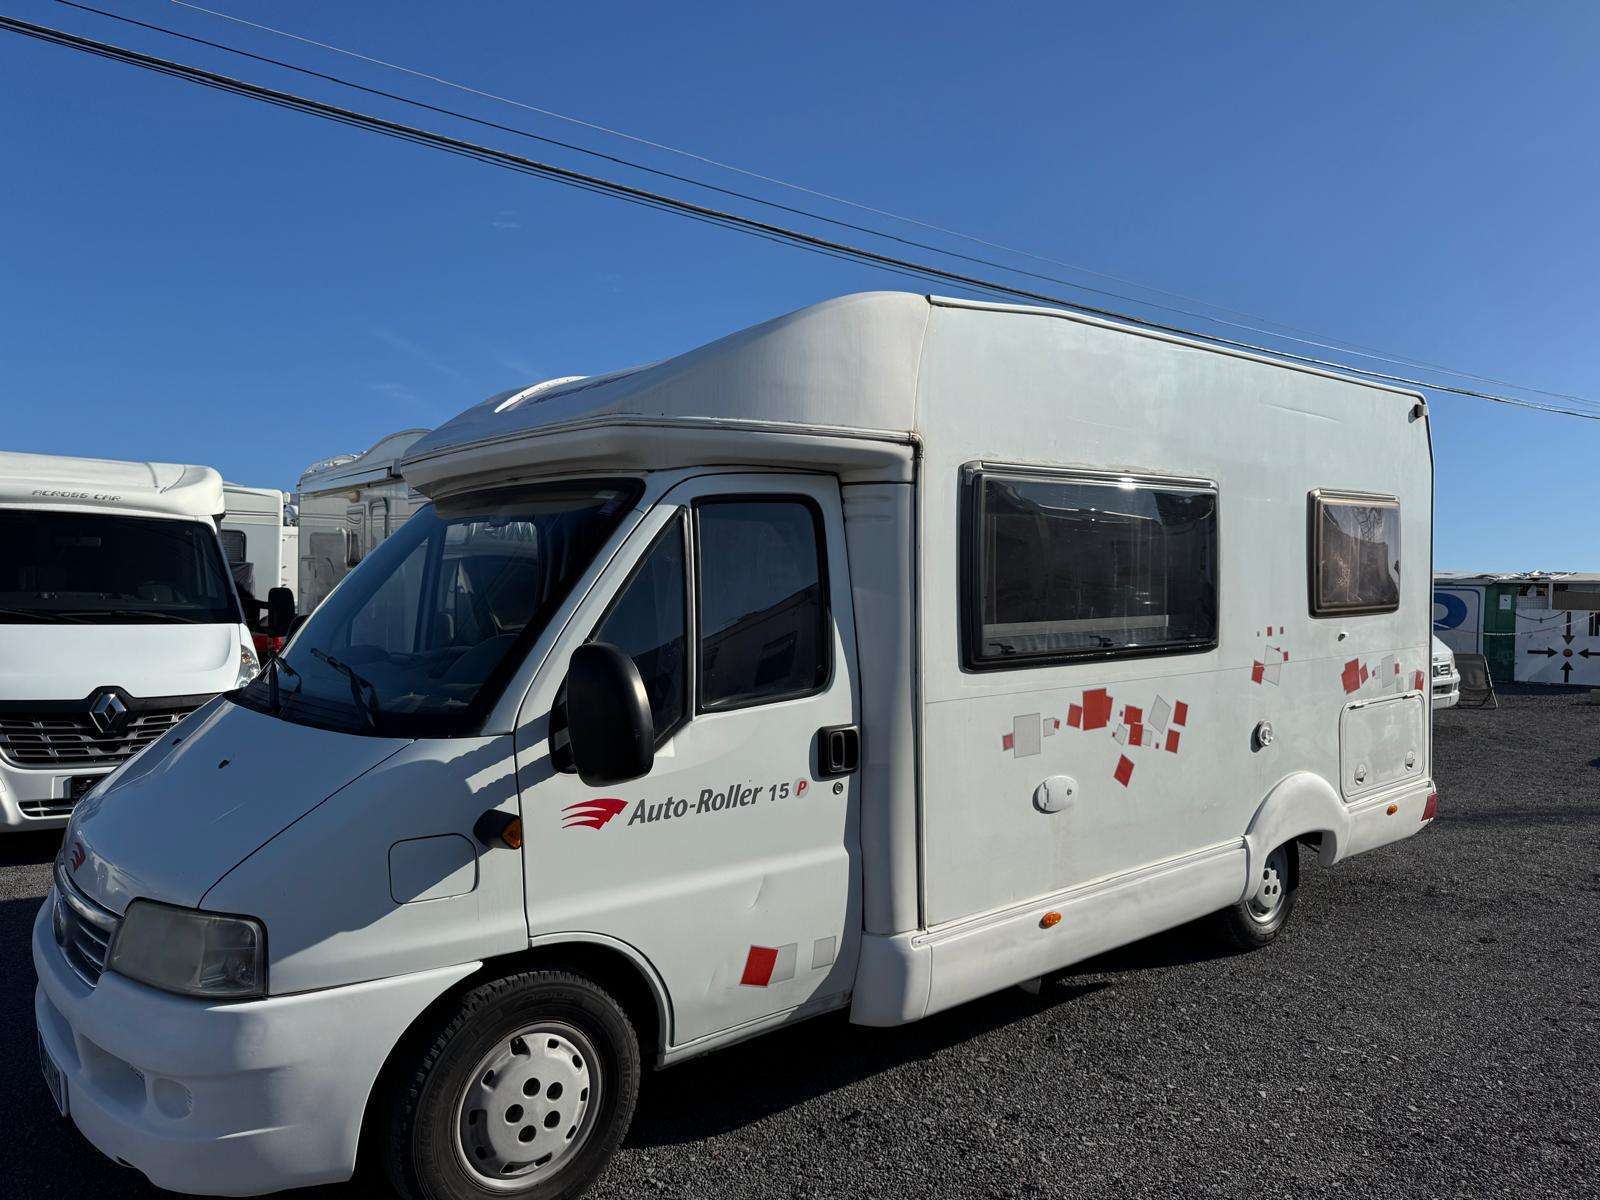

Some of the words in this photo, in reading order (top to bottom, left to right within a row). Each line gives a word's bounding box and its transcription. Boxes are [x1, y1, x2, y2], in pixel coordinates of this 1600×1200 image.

[32, 489, 89, 499] ACROSS
[94, 493, 121, 501] CAR
[627, 783, 763, 826] Auto-Roller
[768, 782, 790, 801] 15
[796, 780, 808, 796] P
